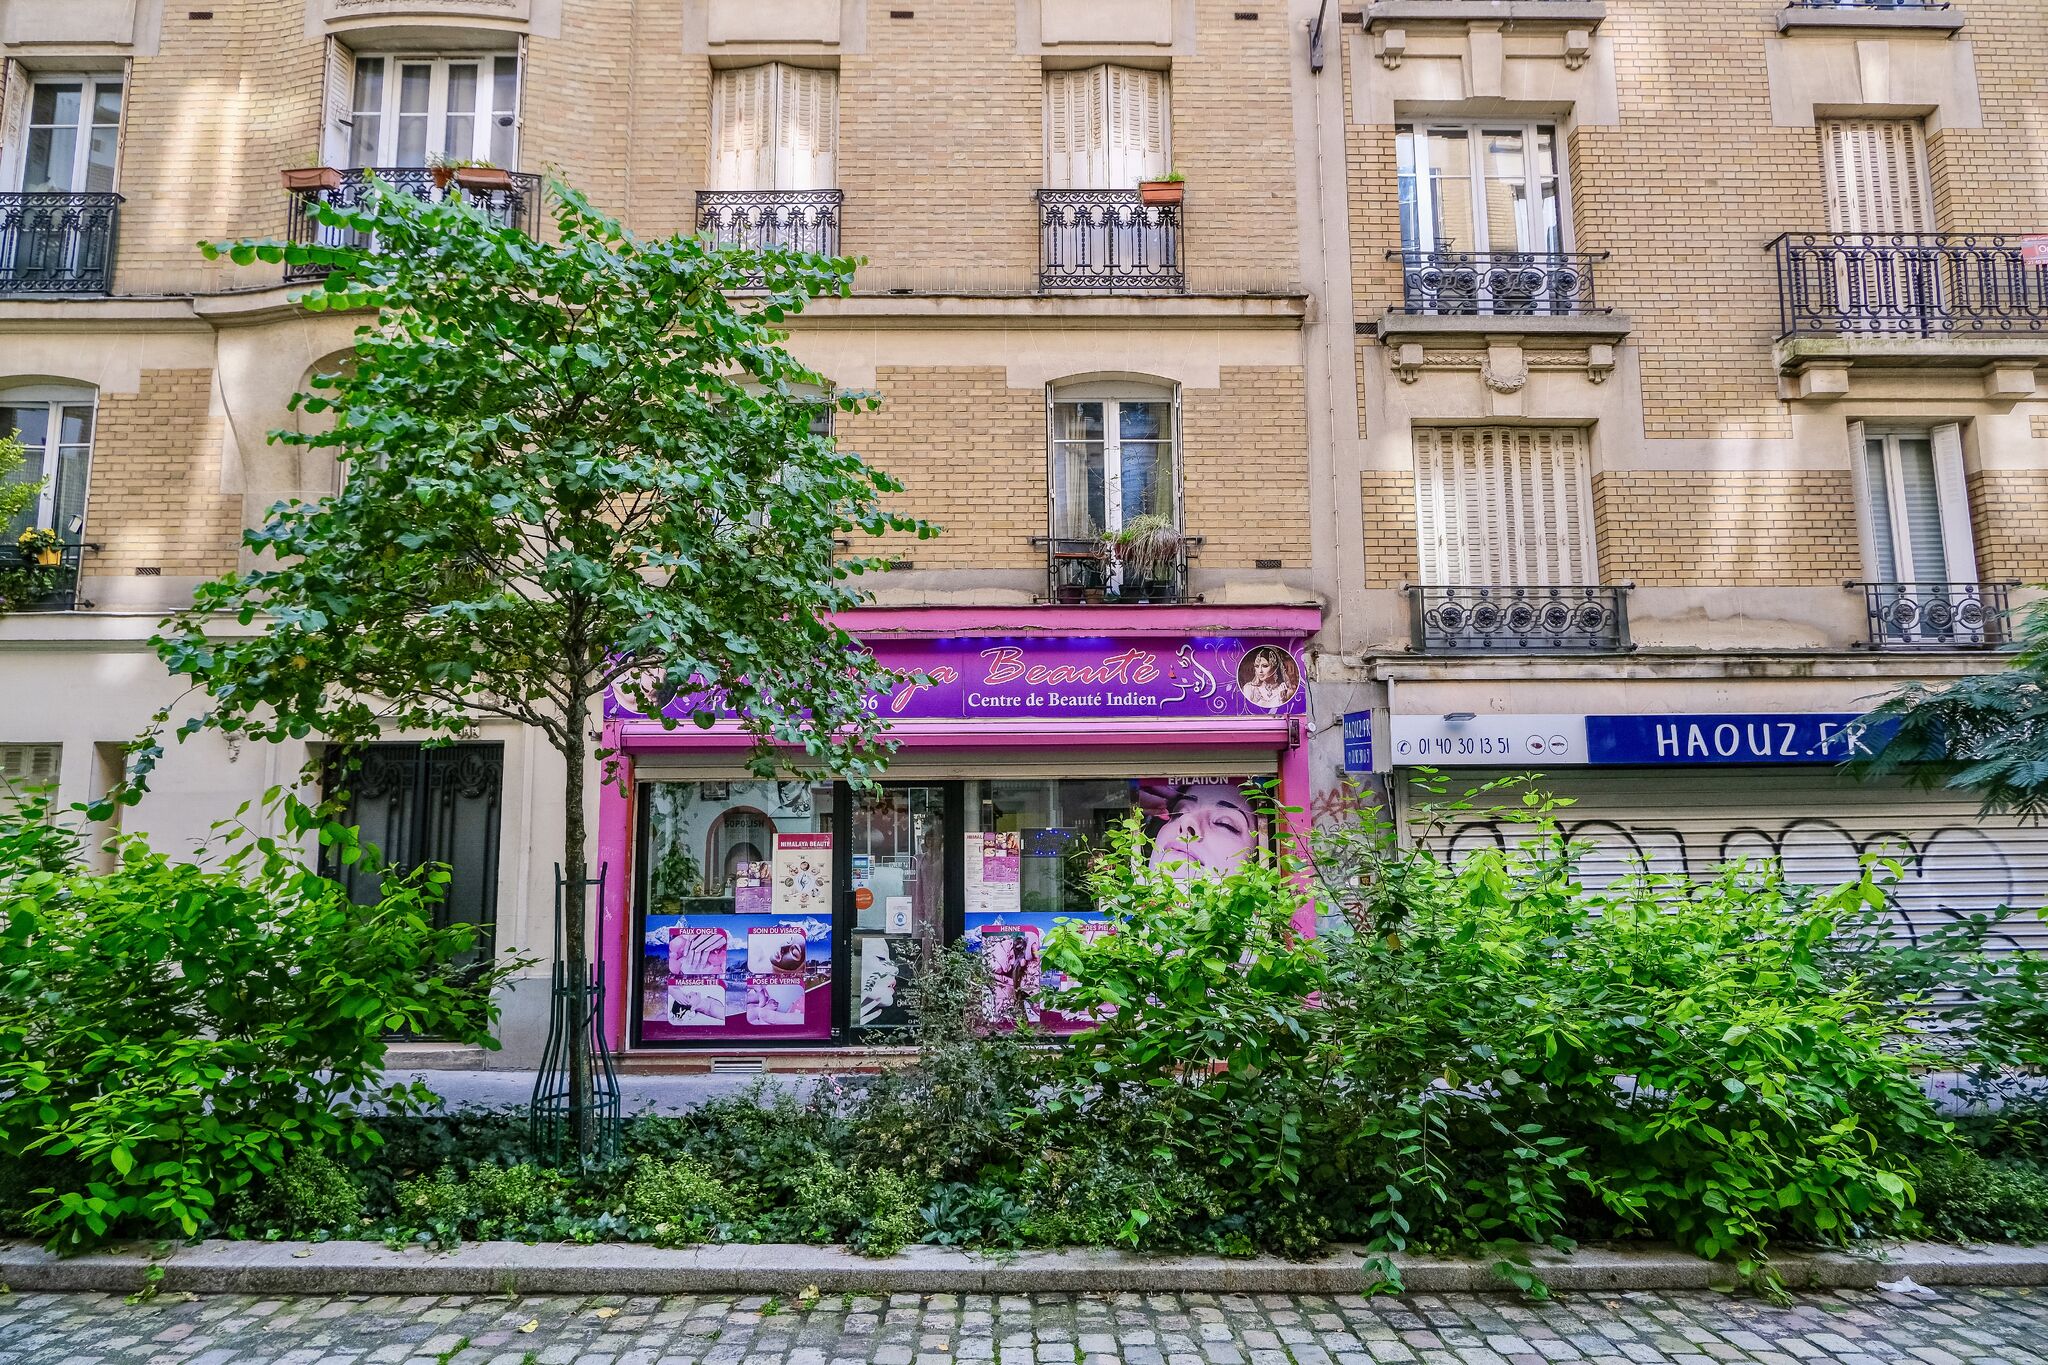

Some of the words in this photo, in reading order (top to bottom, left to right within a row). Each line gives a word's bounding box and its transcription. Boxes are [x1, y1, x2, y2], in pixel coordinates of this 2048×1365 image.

[981, 646, 1160, 685] Beauté
[968, 692, 1021, 707] Centre
[1026, 692, 1044, 707] de
[1048, 692, 1102, 707] Beauté
[1106, 692, 1157, 707] Indien
[1418, 738, 1431, 754] 01
[1436, 738, 1452, 754] 40
[1458, 737, 1474, 754] 30
[1480, 737, 1493, 754] 13
[1498, 737, 1510, 754] 51
[1655, 722, 1874, 757] HAOUZ.FR
